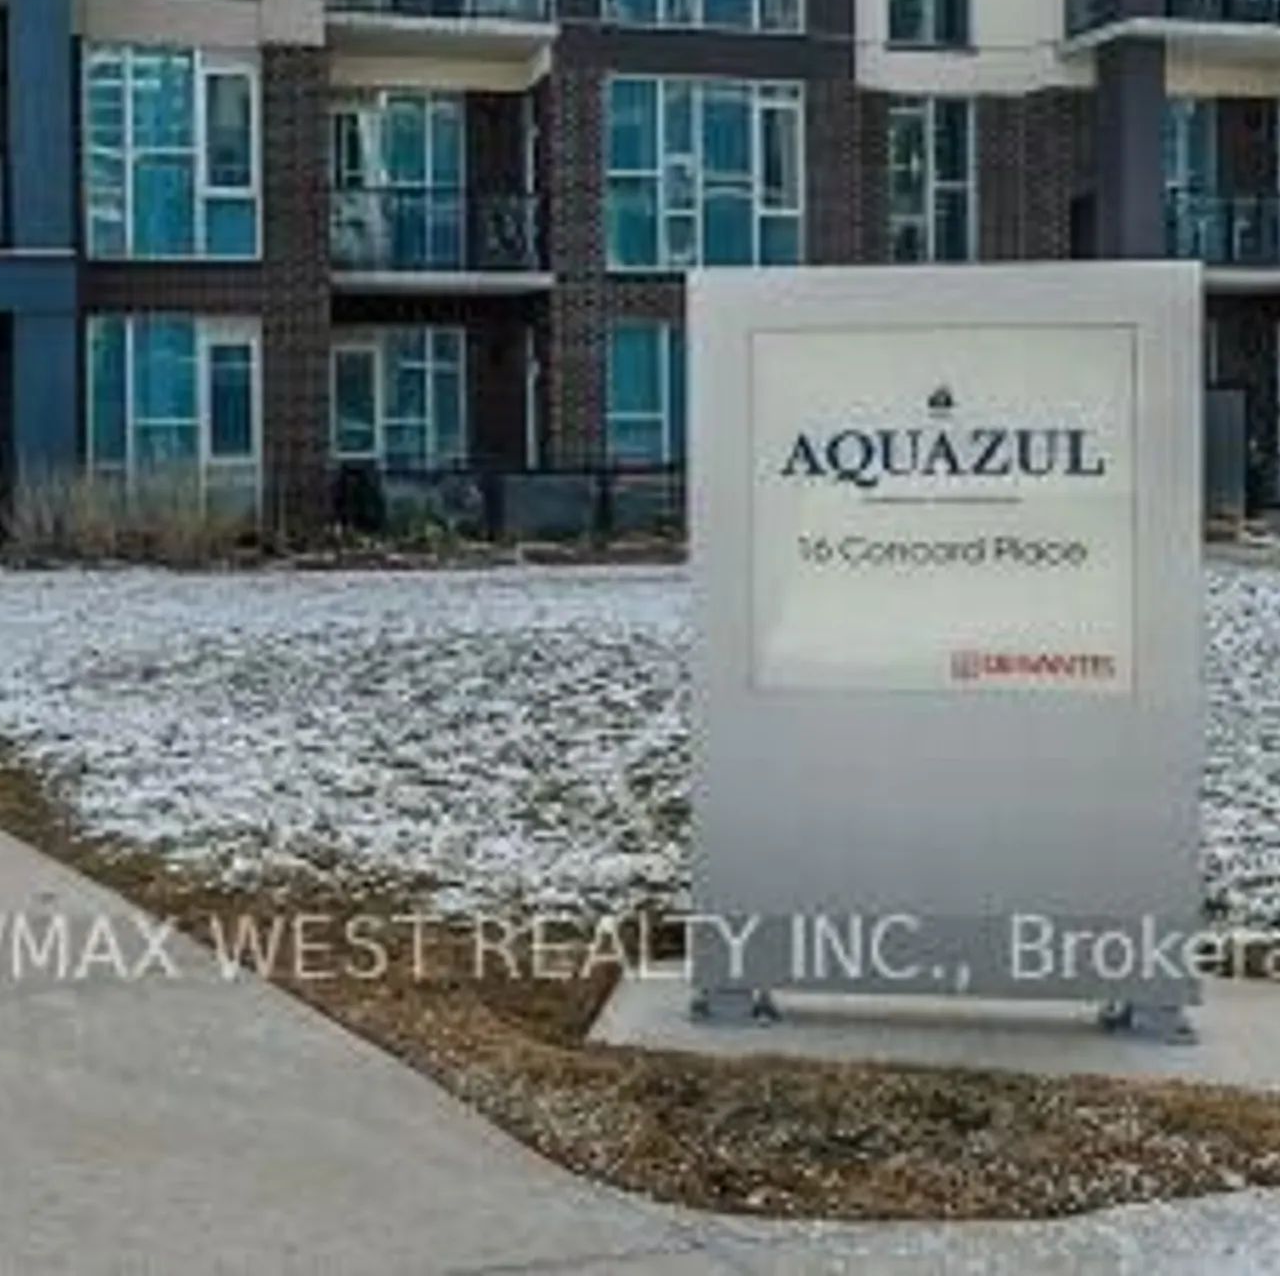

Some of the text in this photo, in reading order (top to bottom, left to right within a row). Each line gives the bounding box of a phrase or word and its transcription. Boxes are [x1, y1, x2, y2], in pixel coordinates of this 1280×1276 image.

[780, 428, 1105, 487] AQUAZUL
[798, 536, 1088, 567] 16 Concord Place
